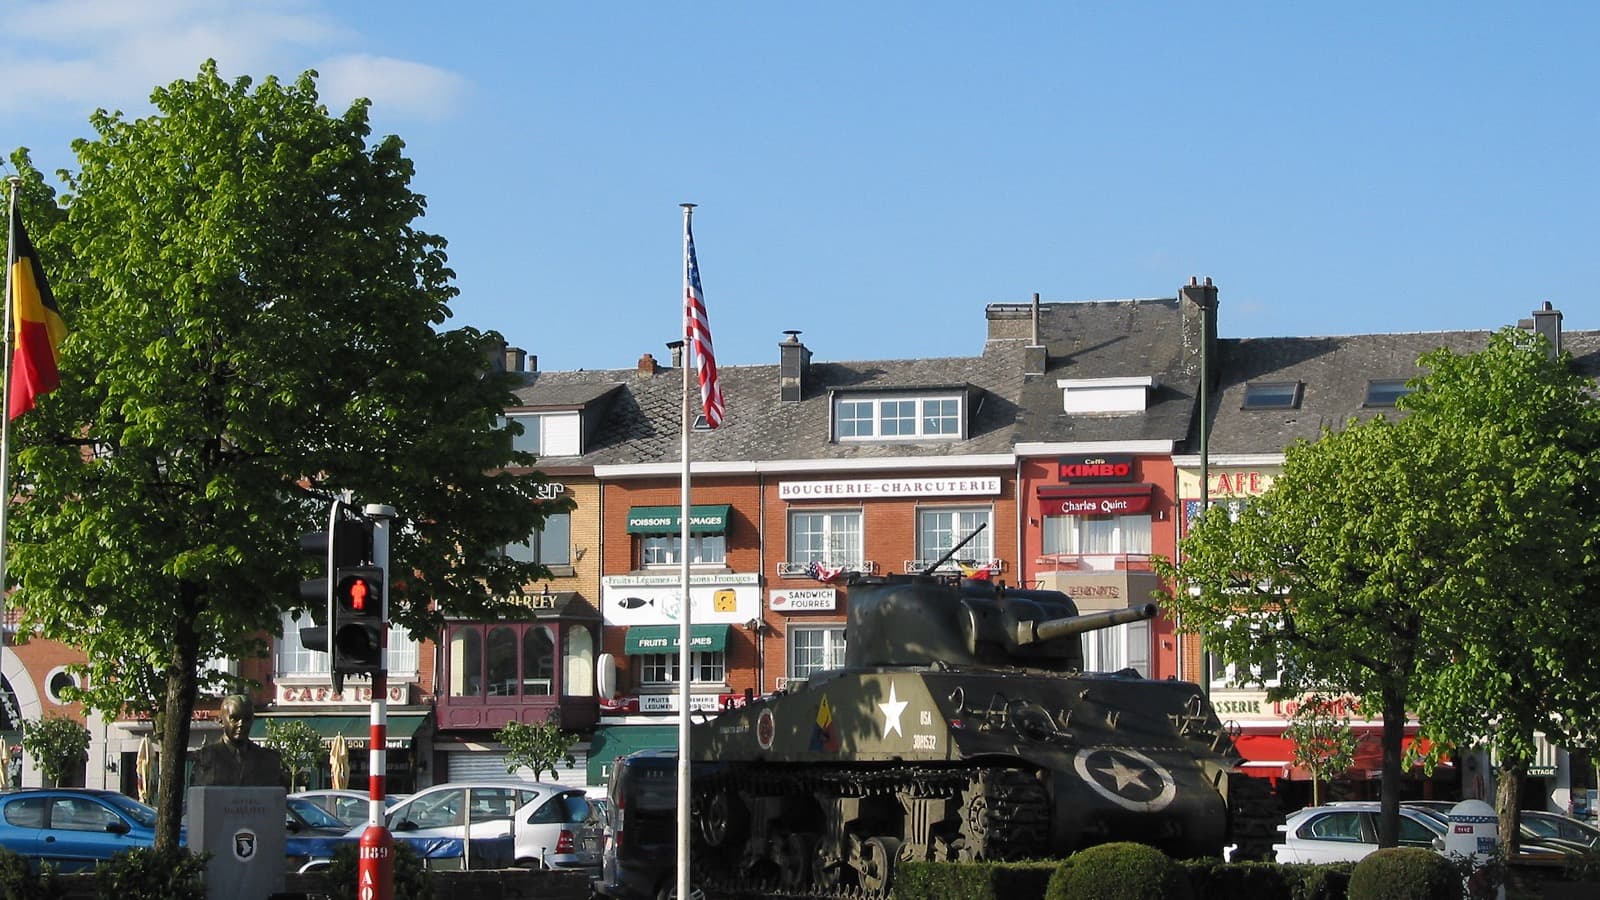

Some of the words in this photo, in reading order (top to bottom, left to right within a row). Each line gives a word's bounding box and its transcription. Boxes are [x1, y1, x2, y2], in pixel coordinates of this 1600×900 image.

[1061, 463, 1130, 477] KIMBO
[1061, 500, 1097, 513] Charles
[1101, 499, 1128, 513] Quint
[630, 518, 671, 526] POISSONS
[676, 516, 722, 525] FOMAGES
[788, 590, 833, 599] SANDWICH
[791, 600, 831, 608] FOURRES
[638, 638, 668, 647] FRUITS
[355, 686, 402, 701] 190
[920, 711, 932, 726] USA
[1526, 768, 1555, 776] L'ETAGE
